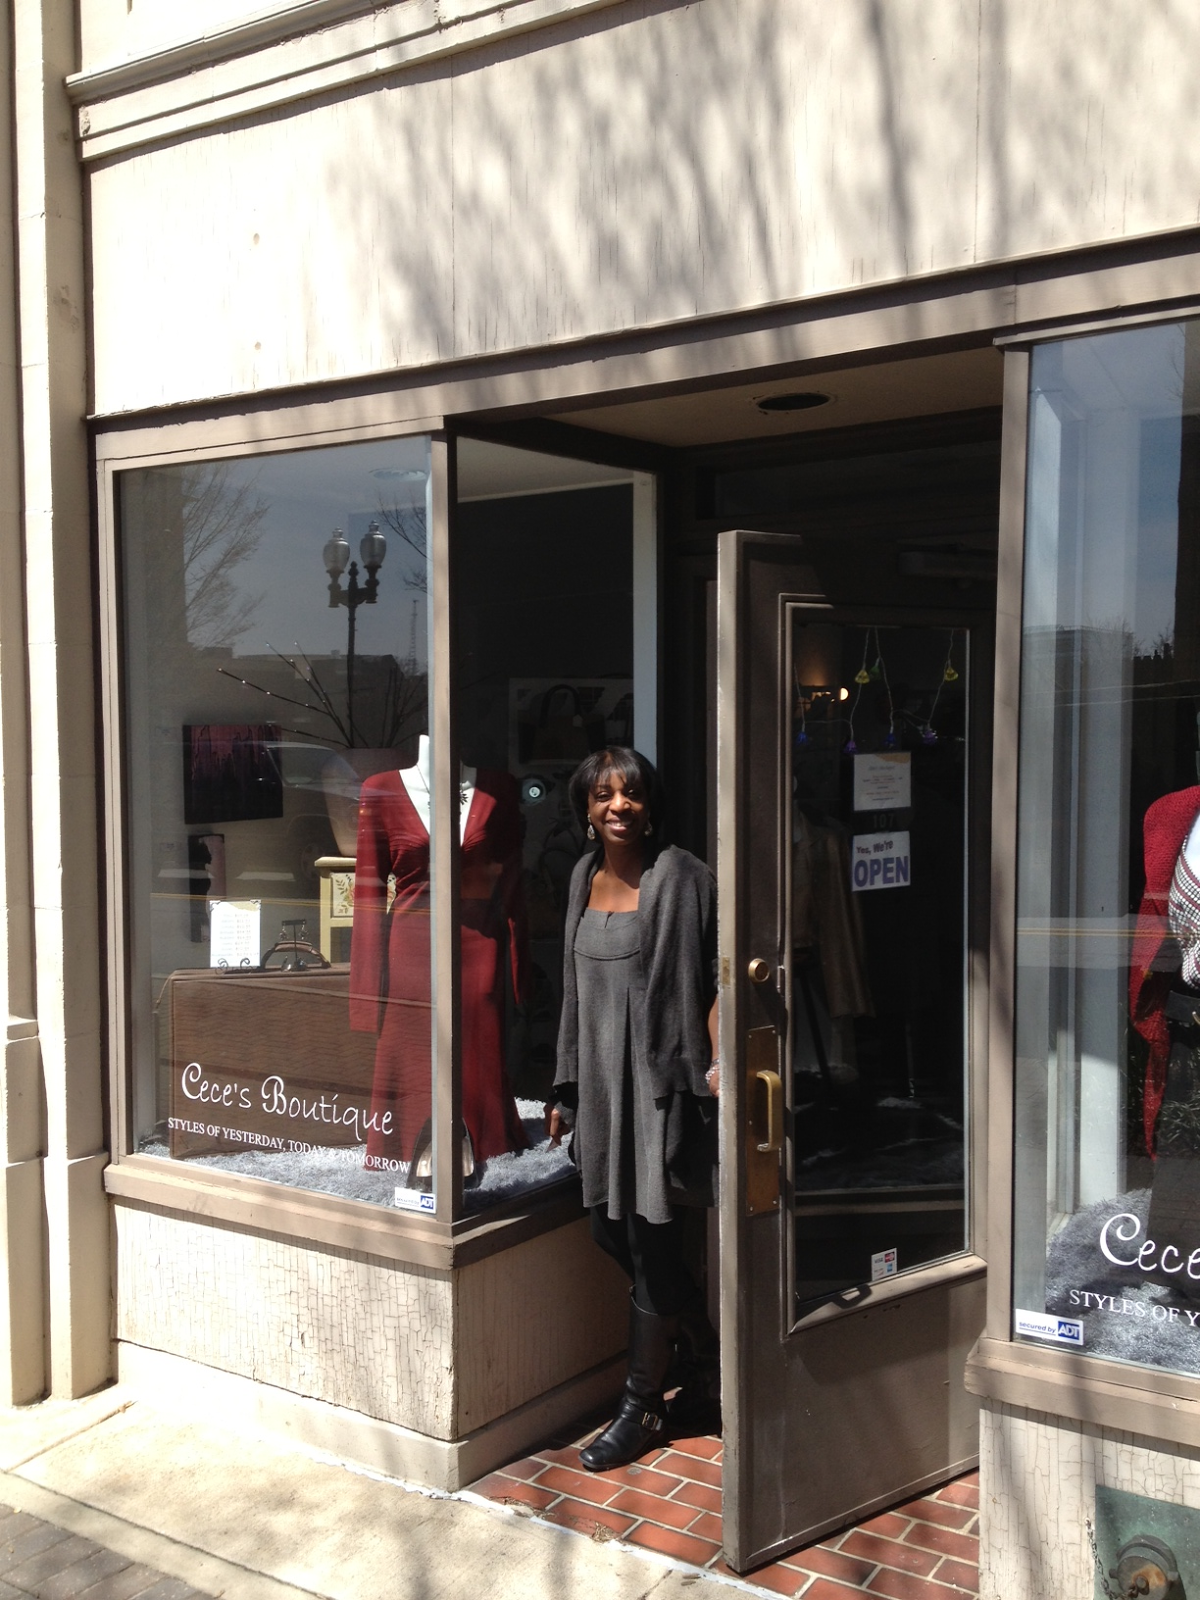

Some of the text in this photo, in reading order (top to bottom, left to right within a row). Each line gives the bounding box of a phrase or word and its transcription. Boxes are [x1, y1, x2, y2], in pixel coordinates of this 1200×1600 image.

[872, 813, 895, 829] 107
[856, 840, 894, 855] Yes, We're
[853, 855, 909, 888] OPEN
[181, 1062, 252, 1109] Cece's
[167, 1116, 206, 1135] STYLES
[206, 1124, 221, 1137] OF
[222, 1126, 286, 1153] YESTERDAY,
[287, 1139, 327, 1157] TODAY
[339, 1150, 412, 1174] TOMORROW
[1069, 1289, 1146, 1318] STYLES
[1152, 1304, 1180, 1323] OF
[1018, 1321, 1080, 1339] secured by ADT
